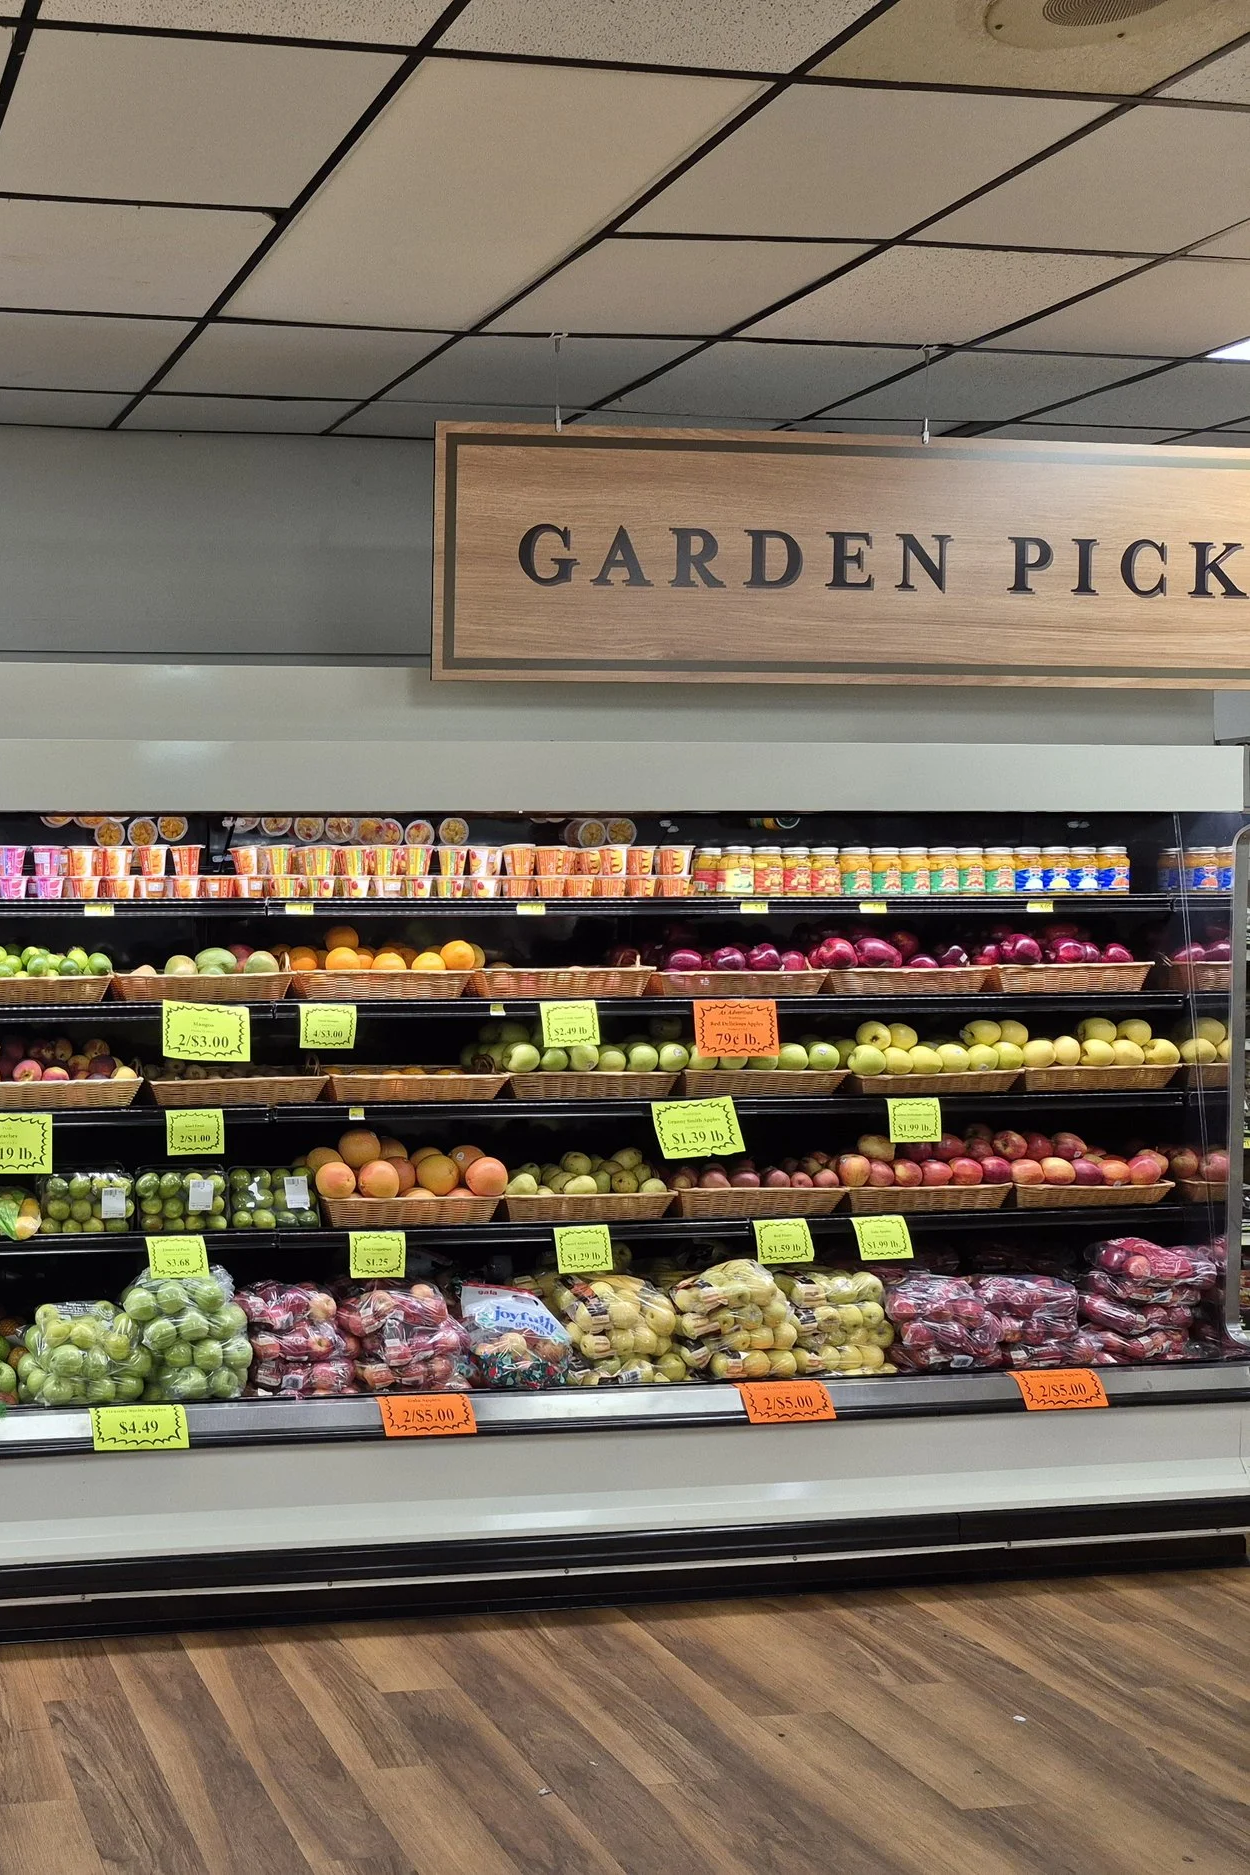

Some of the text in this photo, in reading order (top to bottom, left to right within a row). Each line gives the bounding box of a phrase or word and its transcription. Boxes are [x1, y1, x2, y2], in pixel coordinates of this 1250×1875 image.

[518, 523, 1248, 599] GARDEN PICK
[554, 1027, 577, 1036] $2.49
[178, 1034, 229, 1049] 2/$3.00
[716, 1033, 760, 1047] 79¢ lb.
[672, 1130, 725, 1145] $1.39 lb
[19, 1147, 37, 1160] lb.
[768, 1244, 790, 1253] $1.59
[166, 1258, 190, 1267] $3.68
[366, 1258, 389, 1266] $1.25
[567, 1253, 590, 1261] $1.29
[494, 1305, 557, 1336] joyfully
[1040, 1383, 1087, 1397] 2/$5.00
[764, 1395, 813, 1410] 2/$5.00
[403, 1408, 455, 1423] 2/$5.00
[119, 1420, 159, 1435] $4.49
